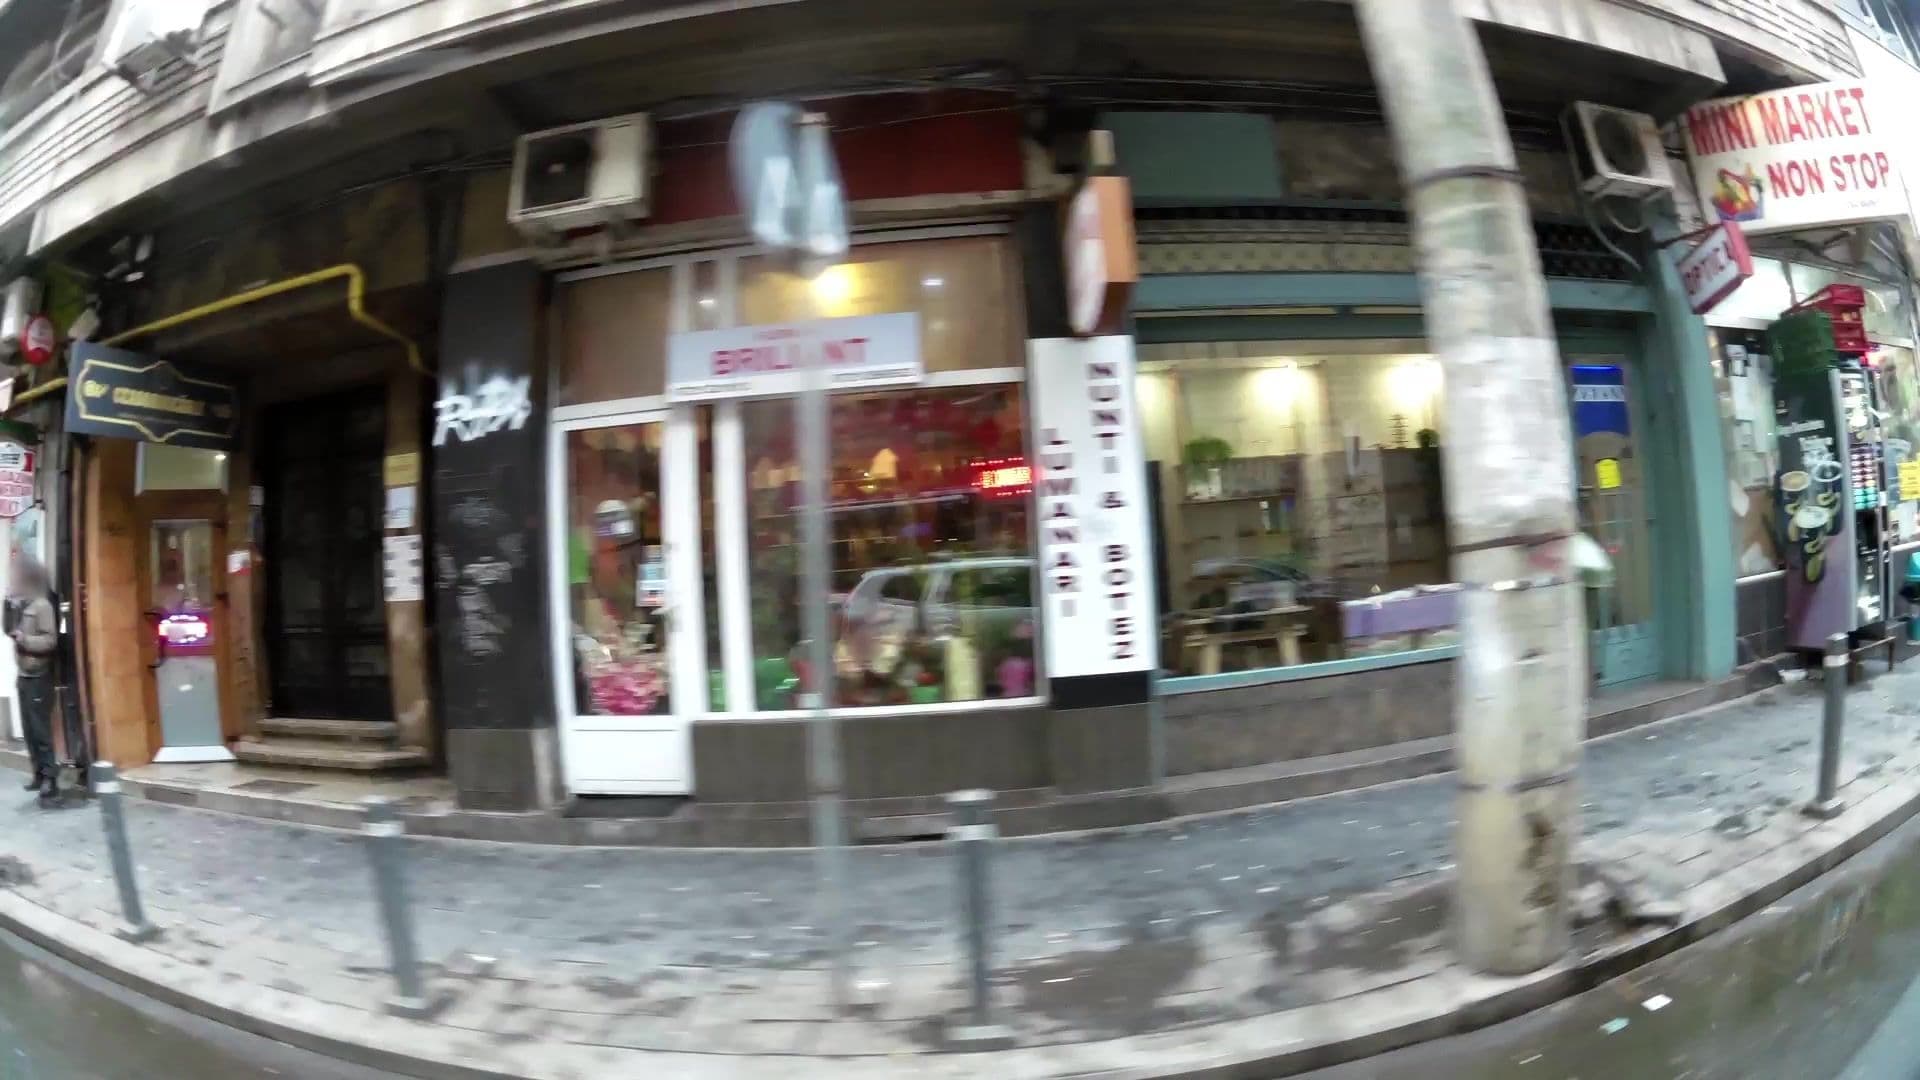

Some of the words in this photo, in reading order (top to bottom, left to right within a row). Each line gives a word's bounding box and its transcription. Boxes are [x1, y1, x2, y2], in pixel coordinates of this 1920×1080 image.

[1688, 101, 1758, 156] MINI
[1757, 87, 1872, 145] MARKET
[1766, 158, 1825, 199] NON
[1829, 151, 1889, 192] STOP
[711, 335, 869, 376] BRILNT
[1102, 543, 1134, 661] BOTEZ
